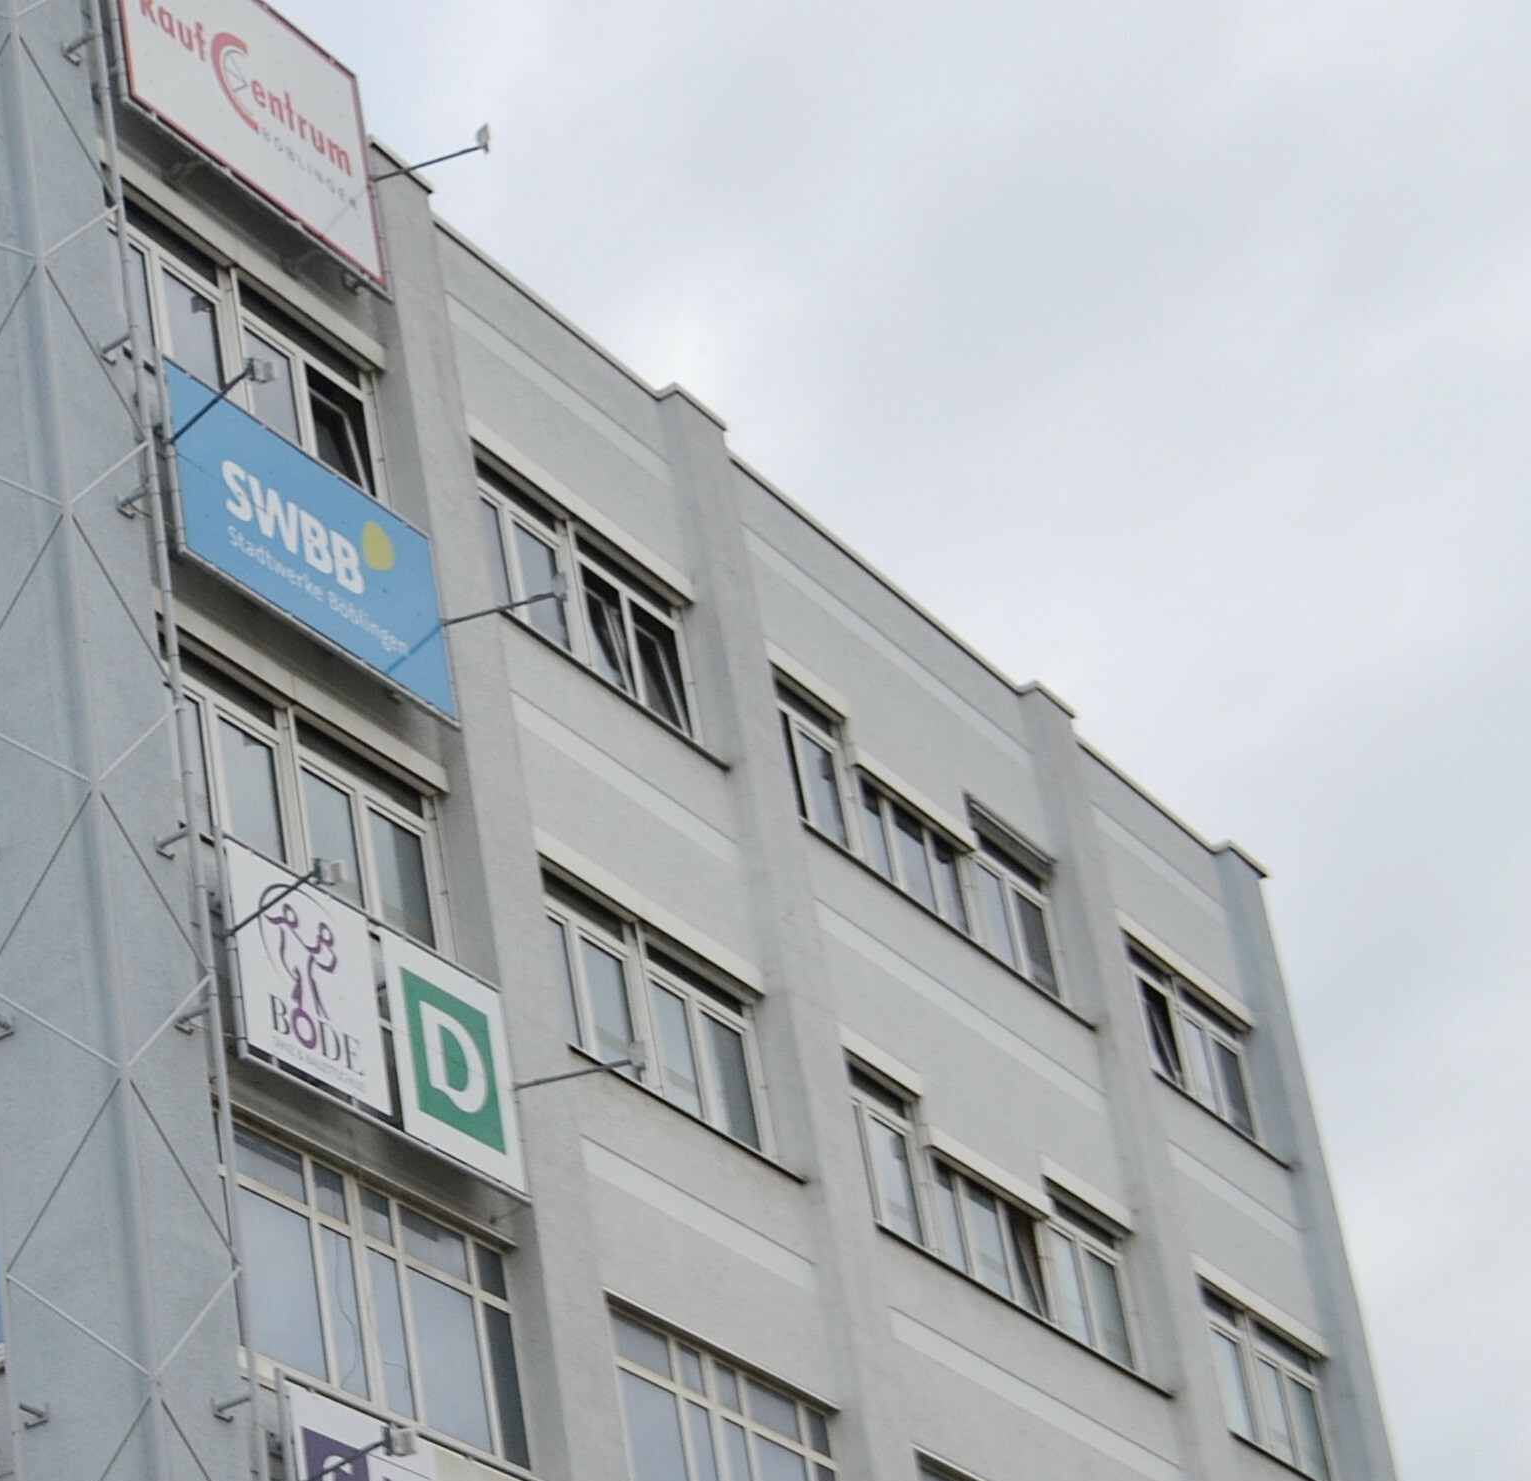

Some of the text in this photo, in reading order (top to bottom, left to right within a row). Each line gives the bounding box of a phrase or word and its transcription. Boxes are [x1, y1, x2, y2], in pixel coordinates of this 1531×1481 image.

[222, 460, 365, 595] SWBB
[227, 525, 408, 656] Stadtwerke Böblingen
[270, 993, 365, 1076] BODE
[419, 1000, 488, 1114] D
